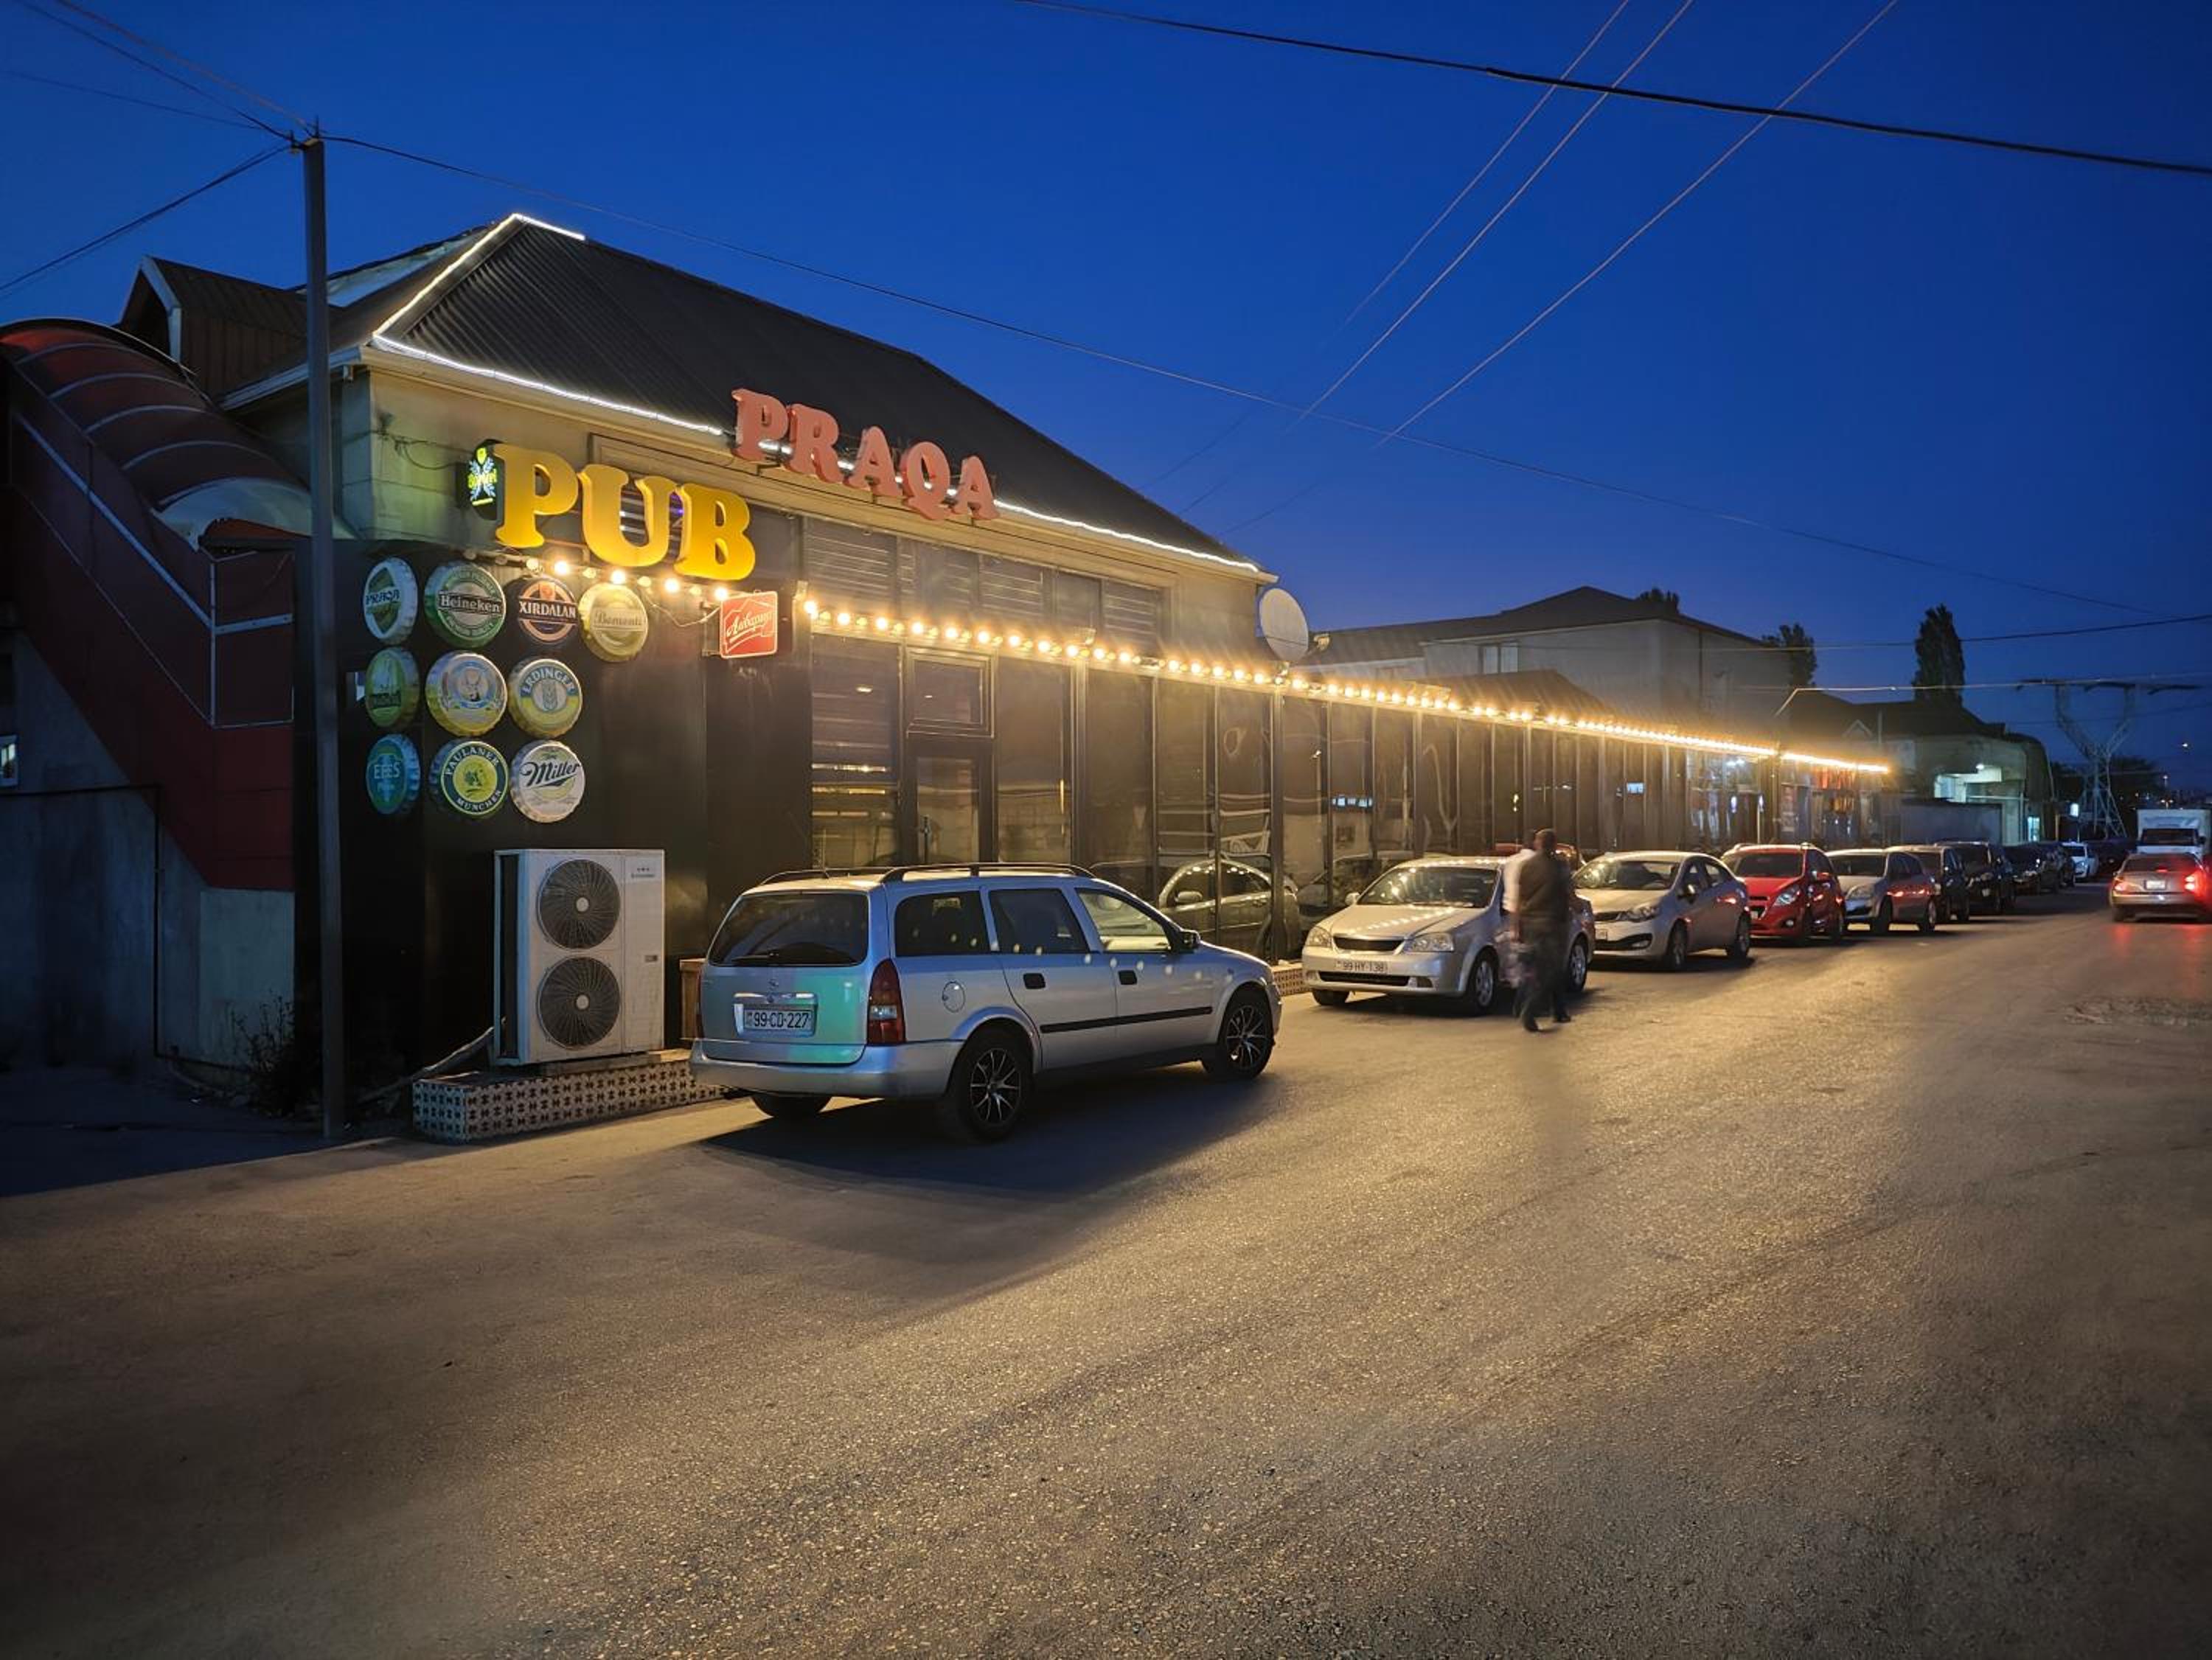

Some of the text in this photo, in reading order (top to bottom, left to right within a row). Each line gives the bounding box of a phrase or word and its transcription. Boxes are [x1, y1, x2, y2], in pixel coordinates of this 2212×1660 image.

[731, 388, 998, 520] PRAQA
[493, 444, 756, 580] PUB
[440, 594, 501, 613] Heineken
[519, 601, 576, 619] XIRDALAN
[522, 667, 575, 693] ERDINGER
[375, 761, 401, 779] EFES
[445, 746, 500, 776] PAULANER
[520, 761, 581, 787] Miller
